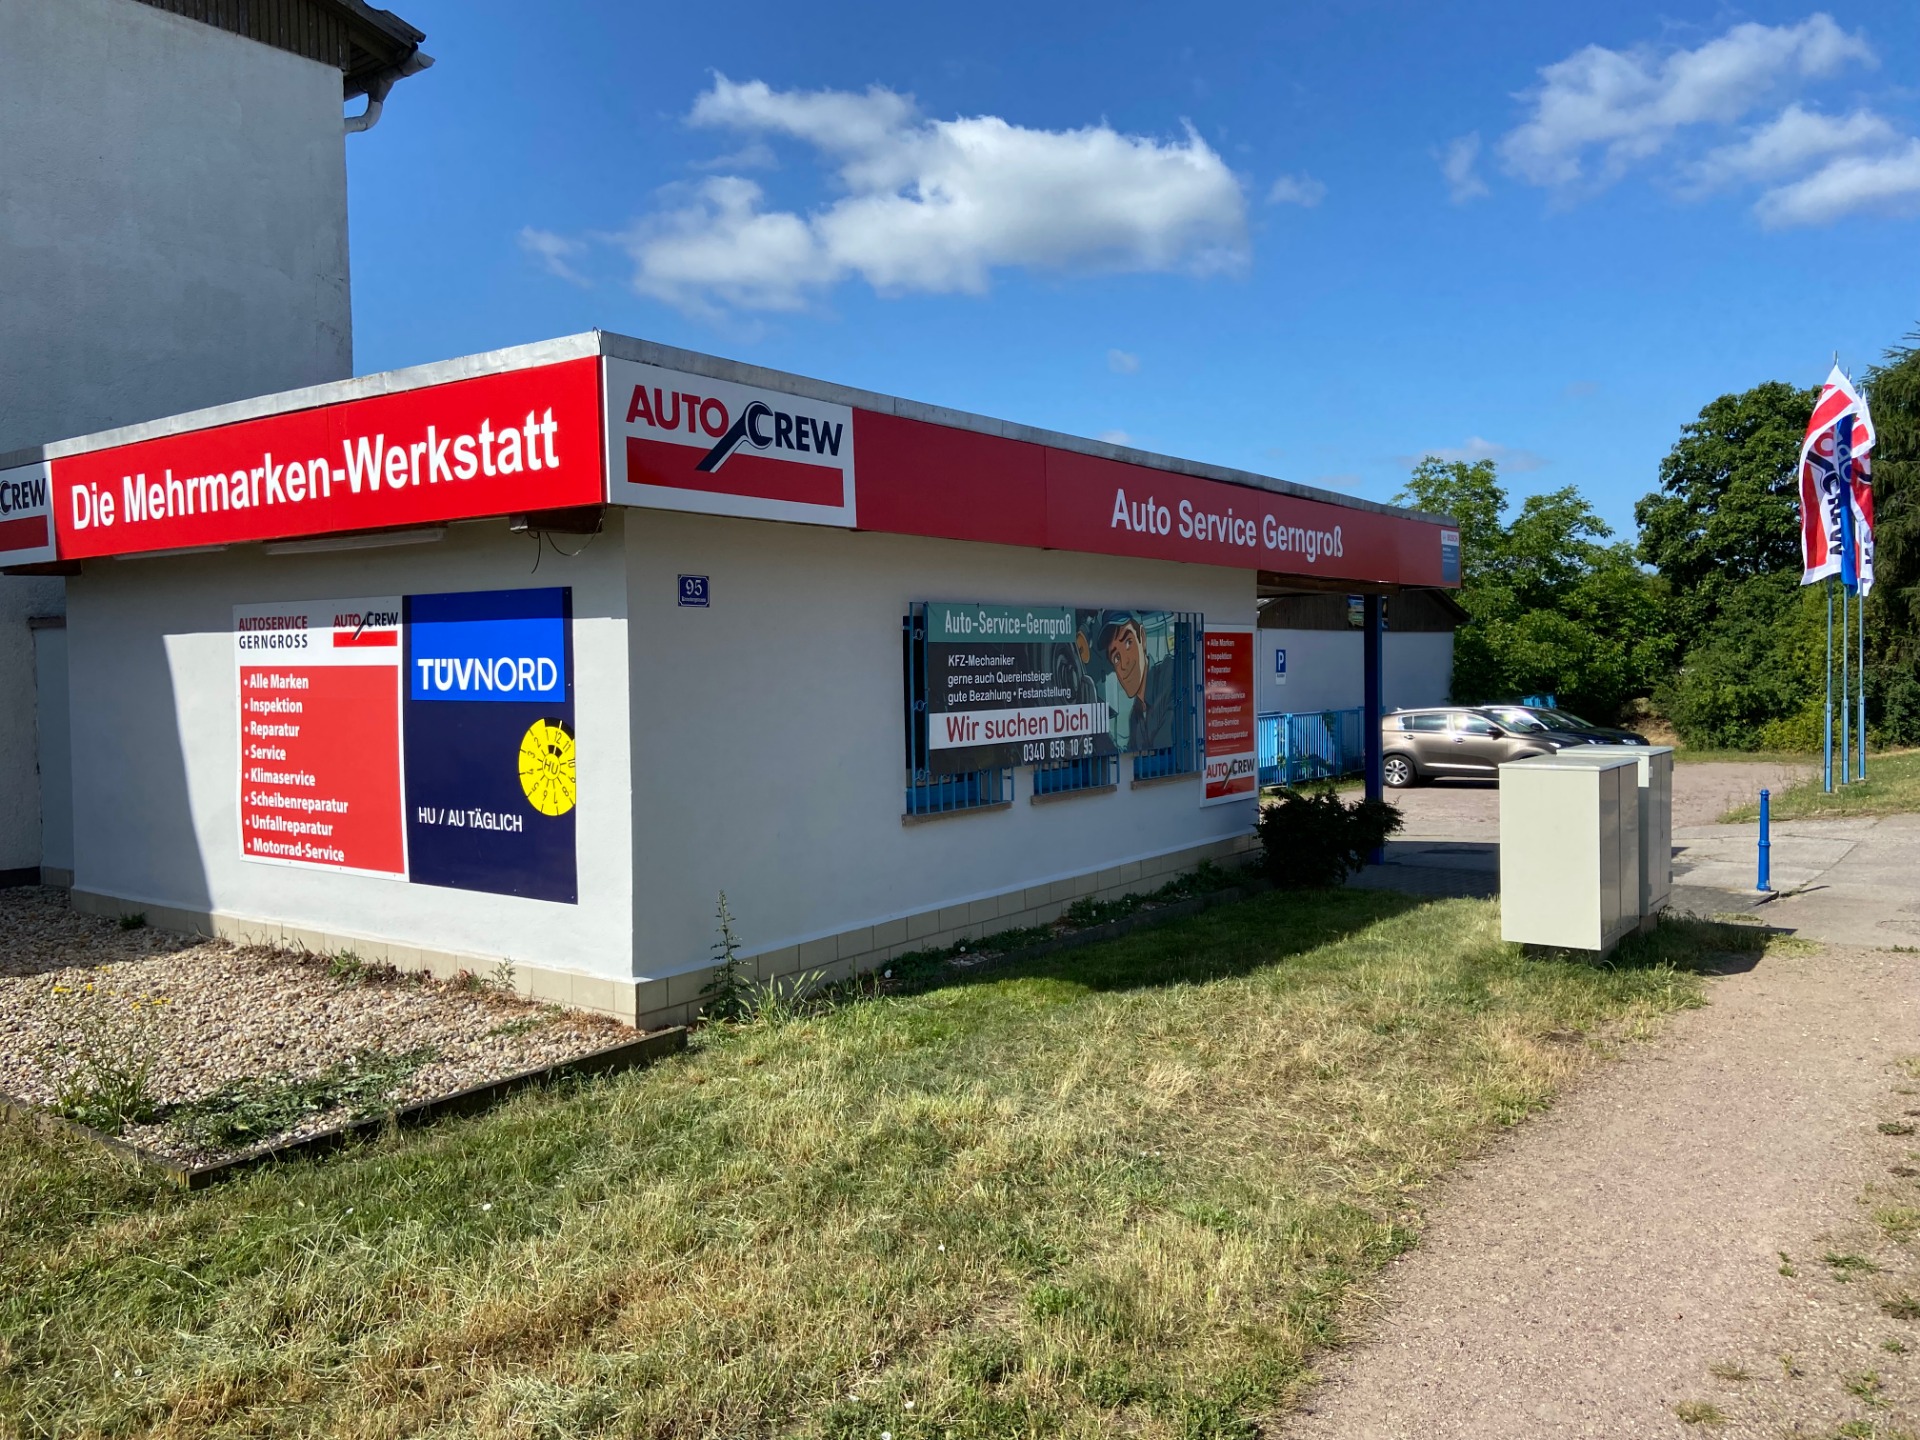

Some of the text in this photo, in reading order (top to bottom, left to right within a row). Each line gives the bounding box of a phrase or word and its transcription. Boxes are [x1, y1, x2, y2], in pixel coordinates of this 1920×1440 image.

[626, 384, 843, 457] AUTO CREW
[72, 407, 560, 530] Die Mehrmarken-Werkstatt
[1111, 488, 1343, 562] Auto Service Gerngroß
[685, 579, 703, 596] 95
[239, 615, 308, 631] AUTOSERVICE
[333, 611, 398, 628] AUTO CREW
[945, 610, 1071, 640] Auto-Service-Gerngroß
[239, 634, 308, 649] GERNGROSS
[948, 654, 1015, 667] KFZ-Mechaniker
[1278, 651, 1284, 671] P
[250, 673, 309, 689] Alle Marken
[948, 671, 1053, 687] gerne auch Quereinsteiger
[948, 686, 1071, 705] gute Bezahlung Festanstellung
[250, 697, 303, 716] Inspektion
[250, 721, 300, 739] Reparatur
[946, 708, 1088, 743] Wir suchen Dich
[250, 744, 286, 760] Service
[1023, 736, 1094, 762] 0340 858 10 95
[543, 758, 559, 775] HU
[1206, 758, 1255, 779] AUTO CREW
[250, 767, 316, 786] Klimaservice
[250, 791, 349, 814] Scheibenreparatur
[251, 814, 333, 836] Unfallreparatur
[418, 806, 436, 825] HU
[448, 809, 465, 828] AU
[467, 808, 522, 833] TÄGLICH
[253, 837, 345, 862] Motorrad-Service
